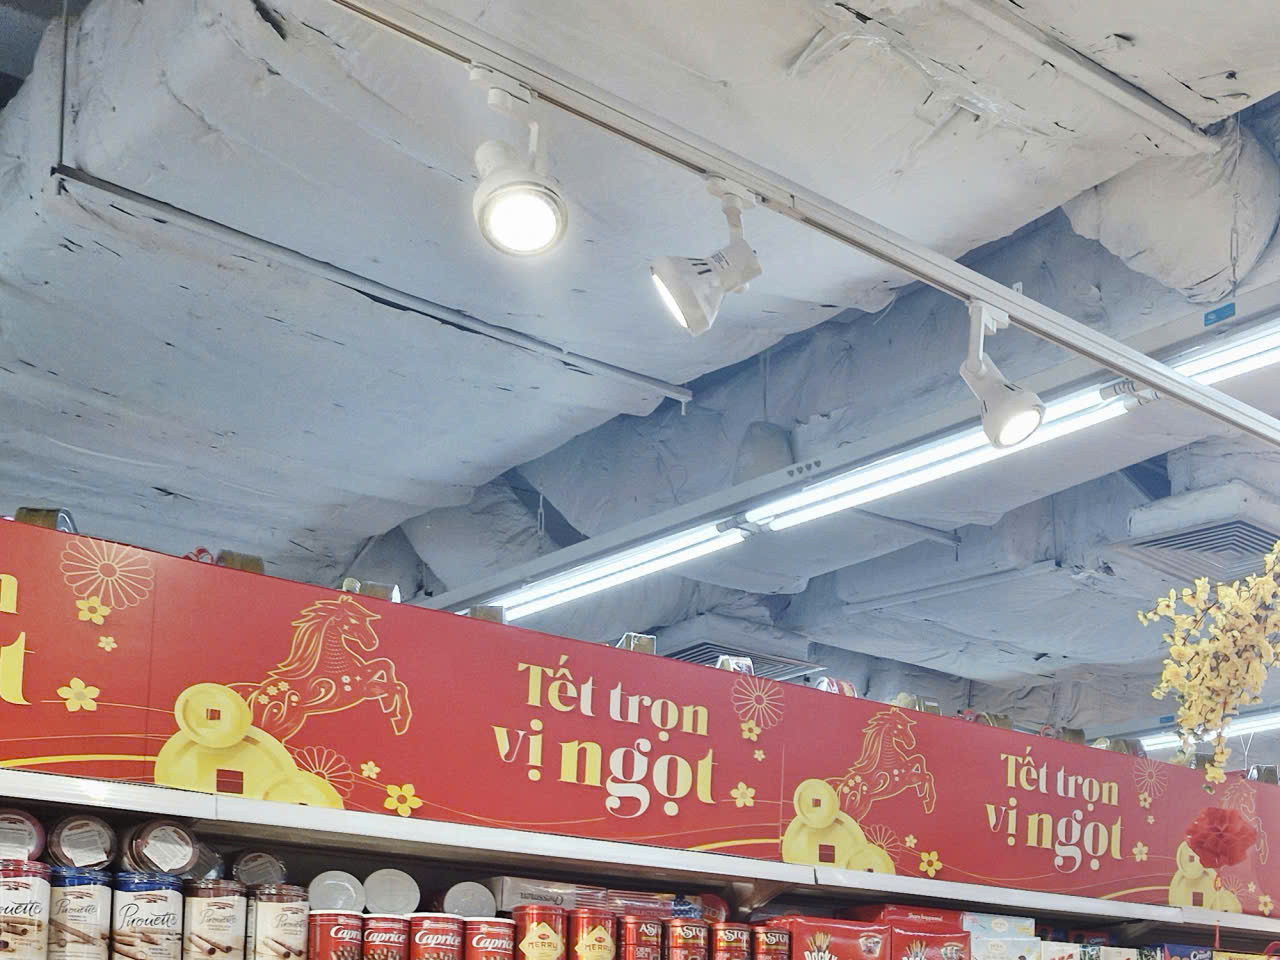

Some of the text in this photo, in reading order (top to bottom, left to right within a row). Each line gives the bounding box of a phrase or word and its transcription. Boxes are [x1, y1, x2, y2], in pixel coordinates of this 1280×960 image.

[518, 655, 709, 741] Tết trọn
[491, 719, 719, 818] vị ngọt
[1001, 746, 1119, 811] Tết trọn
[985, 797, 1125, 873] vị ngọt
[119, 903, 177, 929] Pirouette
[364, 929, 406, 943] Caprice
[414, 930, 461, 946] Caprice
[528, 941, 558, 950] MERRY
